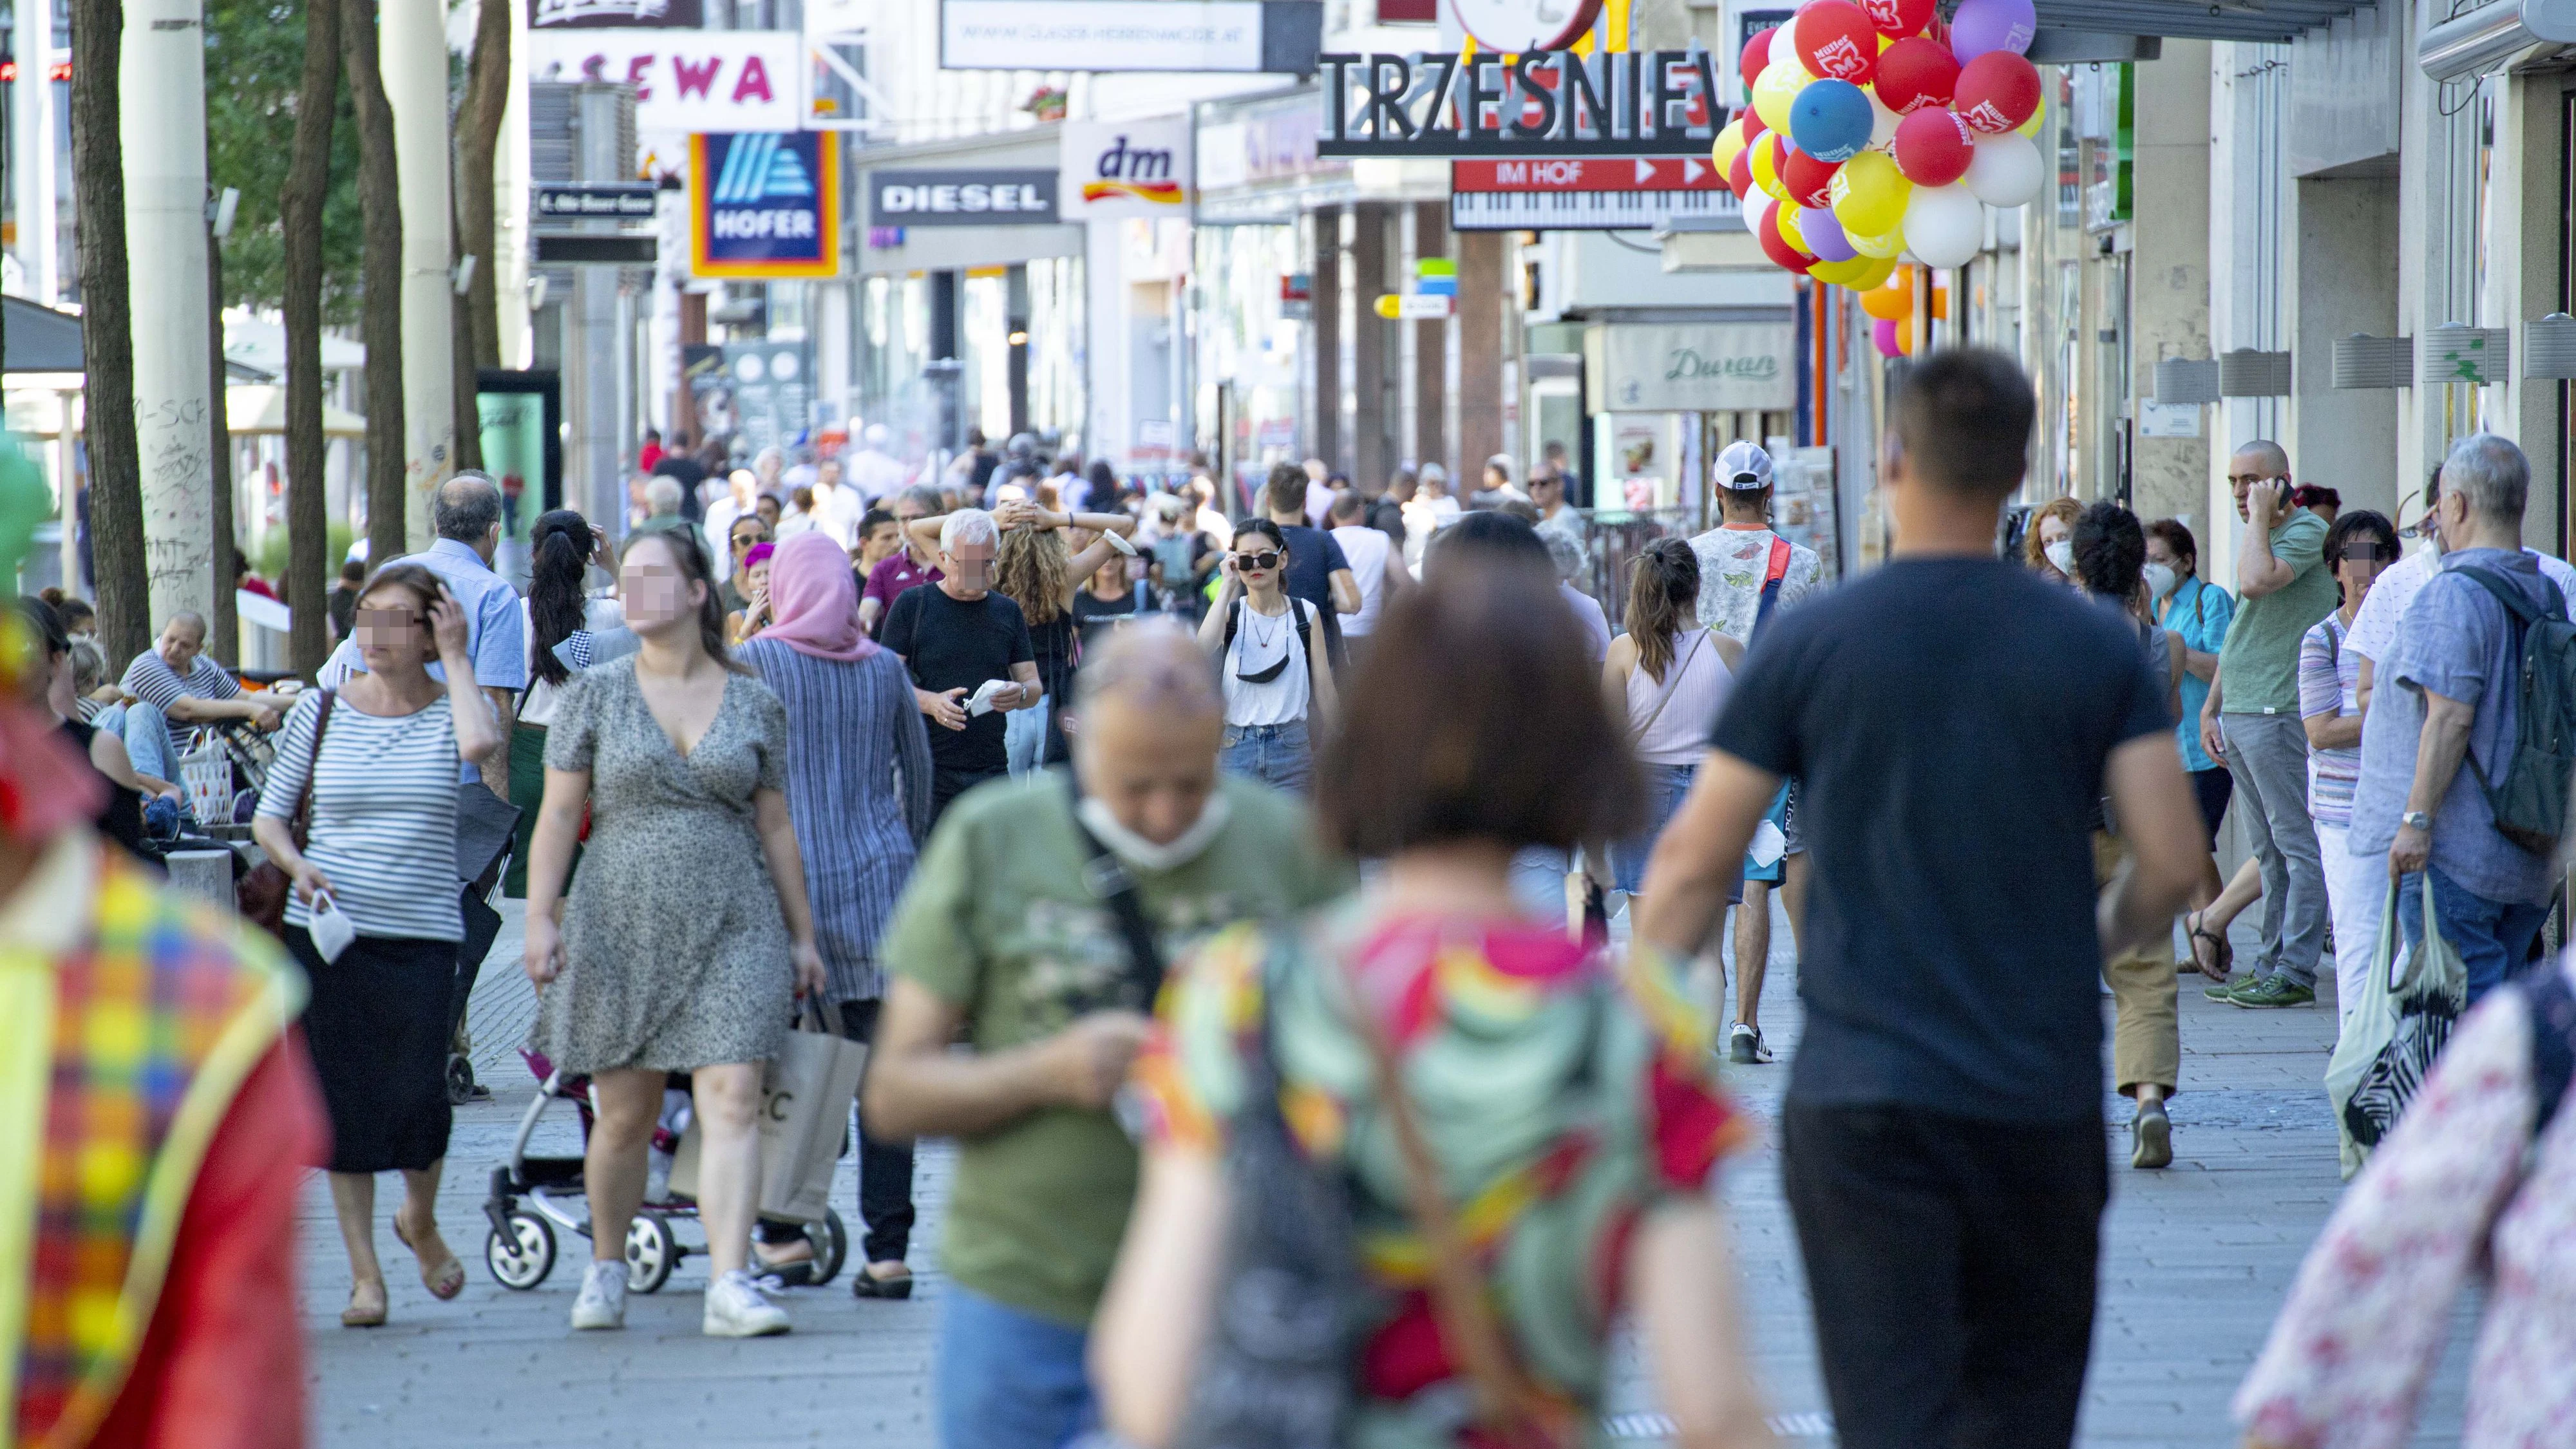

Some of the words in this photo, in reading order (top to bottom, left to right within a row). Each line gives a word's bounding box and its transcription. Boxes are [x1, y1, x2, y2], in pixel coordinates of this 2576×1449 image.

[1813, 34, 1848, 60] Müller
[1318, 39, 1726, 140] TRZEŚNIE
[1981, 99, 2013, 125] Müller
[1099, 135, 1171, 180] dm
[1496, 162, 1527, 184] IM
[1532, 161, 1583, 184] HOF
[881, 183, 1049, 213] DIESEL
[714, 208, 815, 239] HOFER
[1664, 346, 1780, 382] Duran
